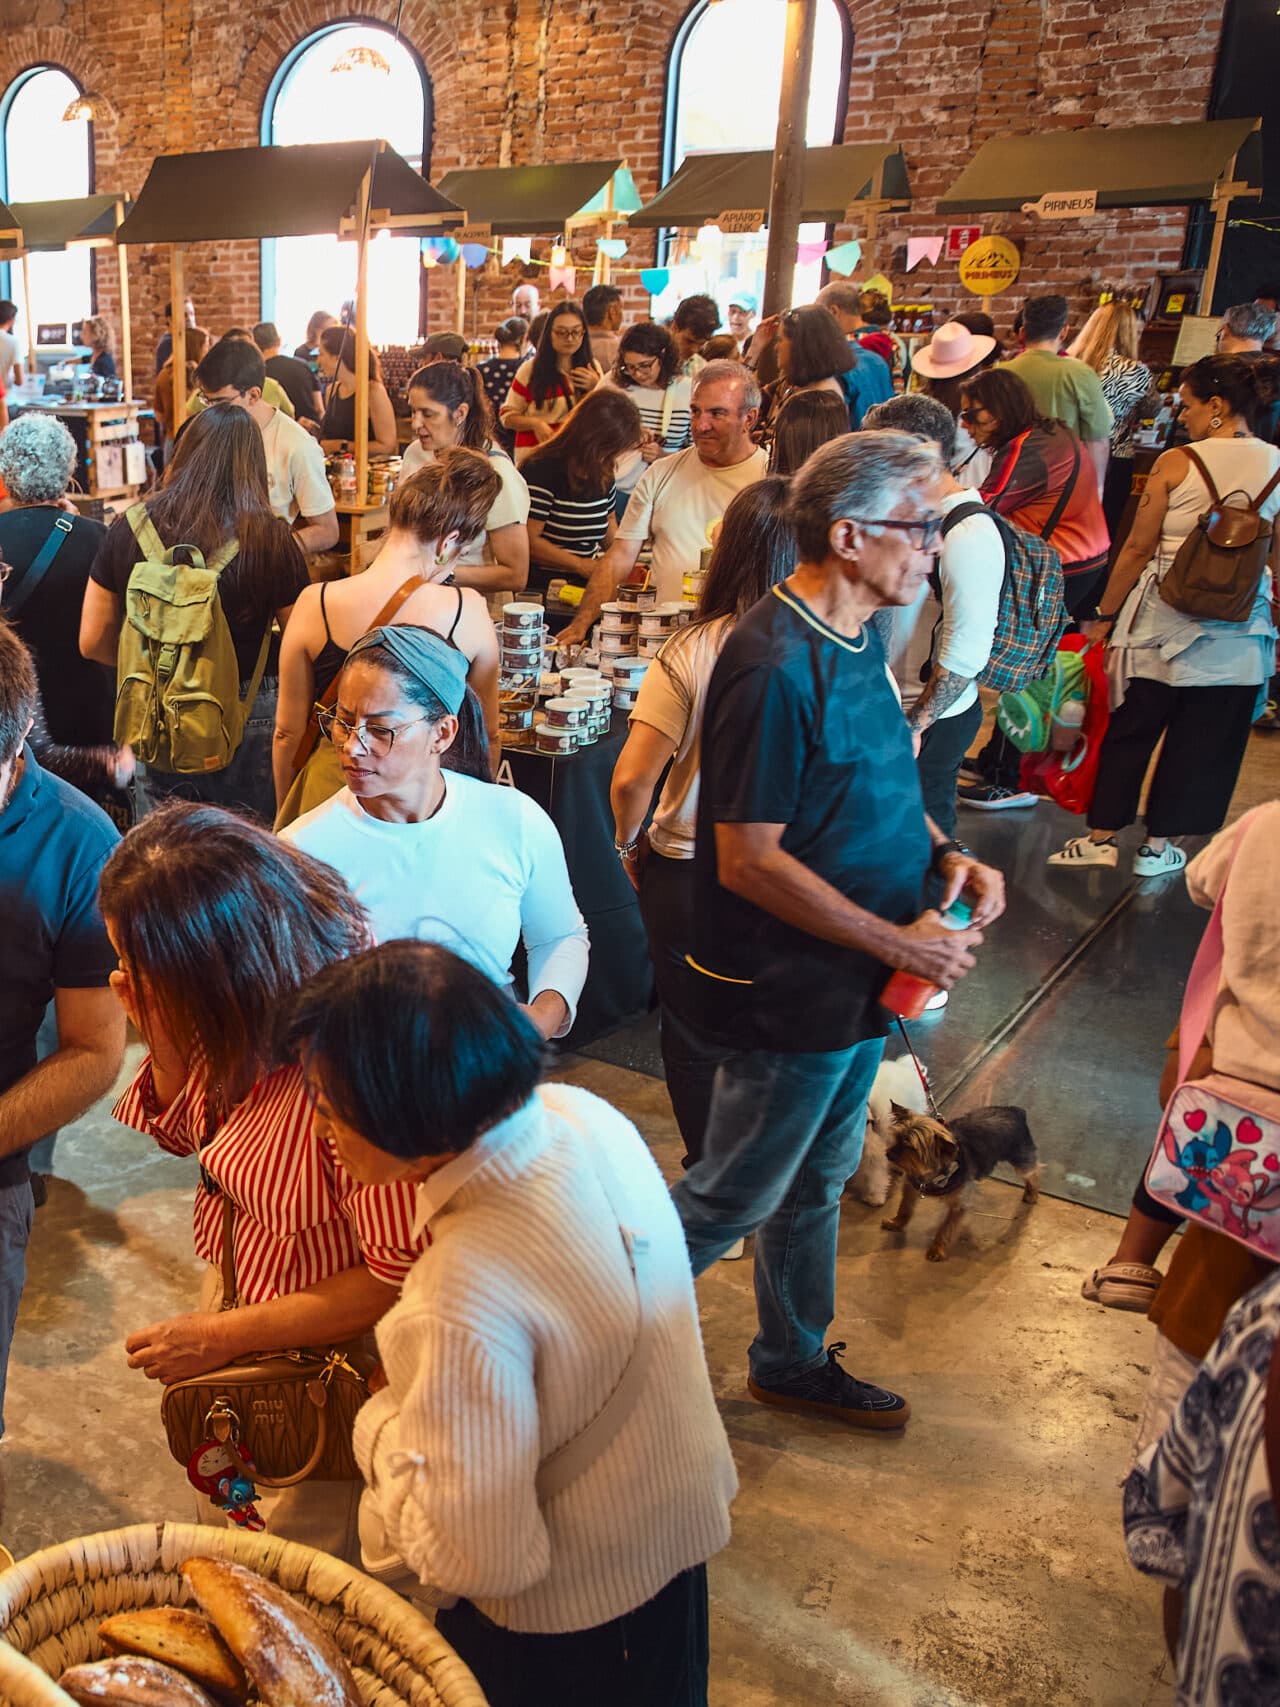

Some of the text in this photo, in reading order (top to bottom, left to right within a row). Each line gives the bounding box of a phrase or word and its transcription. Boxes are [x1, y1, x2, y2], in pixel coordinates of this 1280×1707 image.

[1043, 198, 1094, 211] PIRINEUS
[252, 1400, 283, 1410] miu
[254, 1413, 285, 1424] miu
